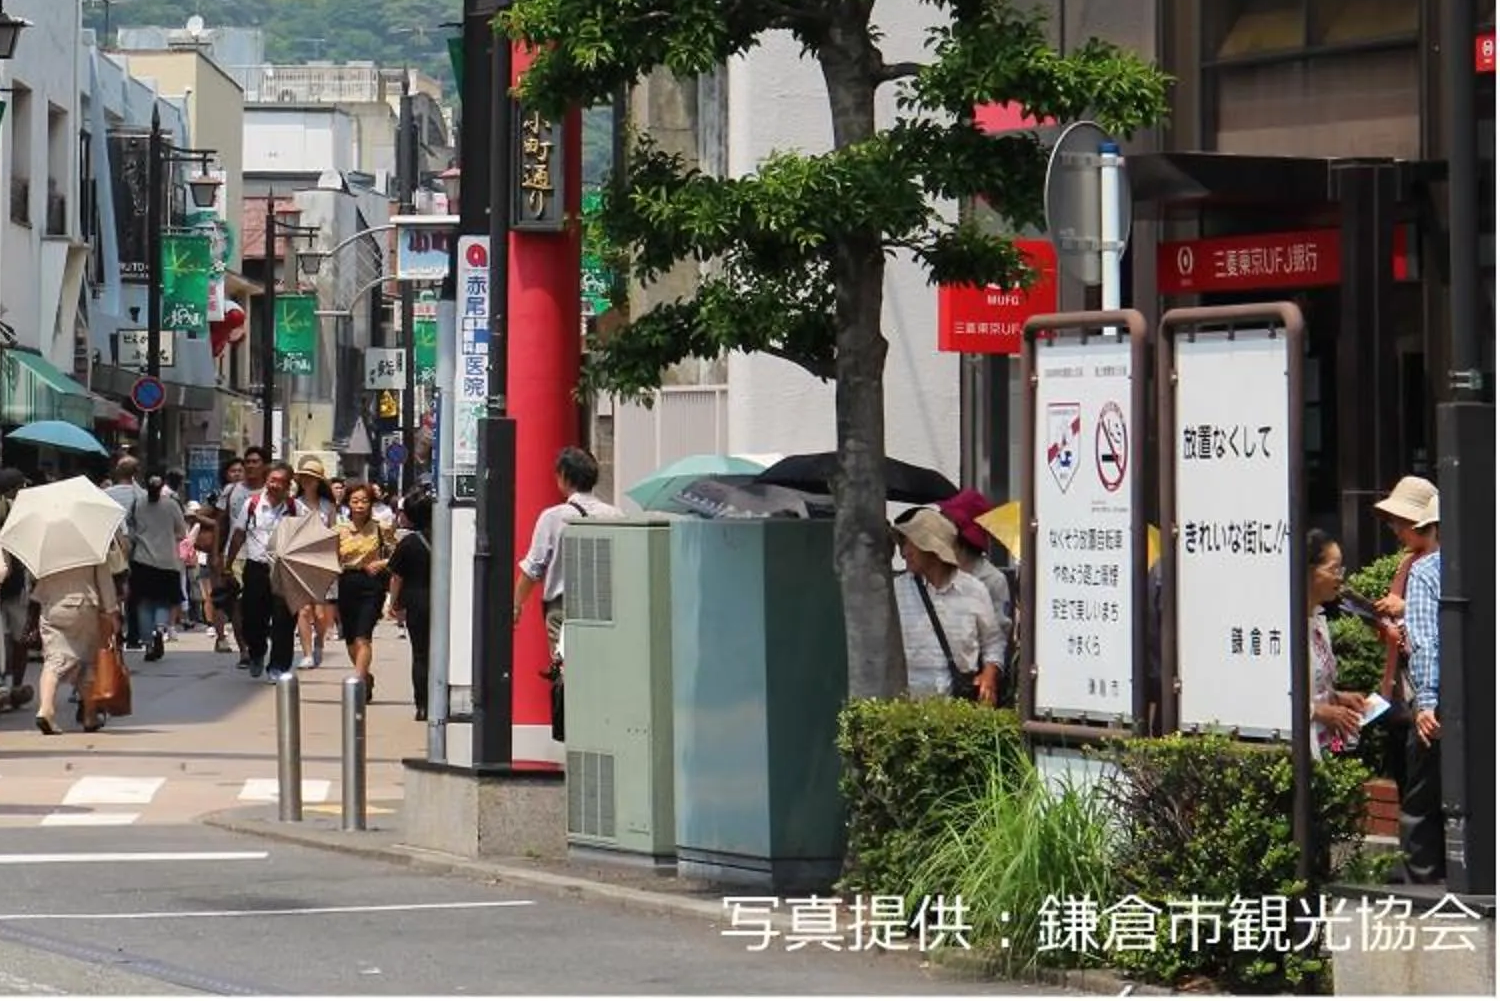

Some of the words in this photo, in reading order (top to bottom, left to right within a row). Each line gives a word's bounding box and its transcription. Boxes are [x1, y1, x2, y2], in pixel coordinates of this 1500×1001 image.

[522, 109, 553, 218] 小町通り
[1214, 244, 1317, 278] 三菱東京UFJ銀行
[955, 322, 1023, 335] 三菱東京UF
[464, 357, 485, 396] 医院
[1183, 426, 1272, 460] 放置なくして
